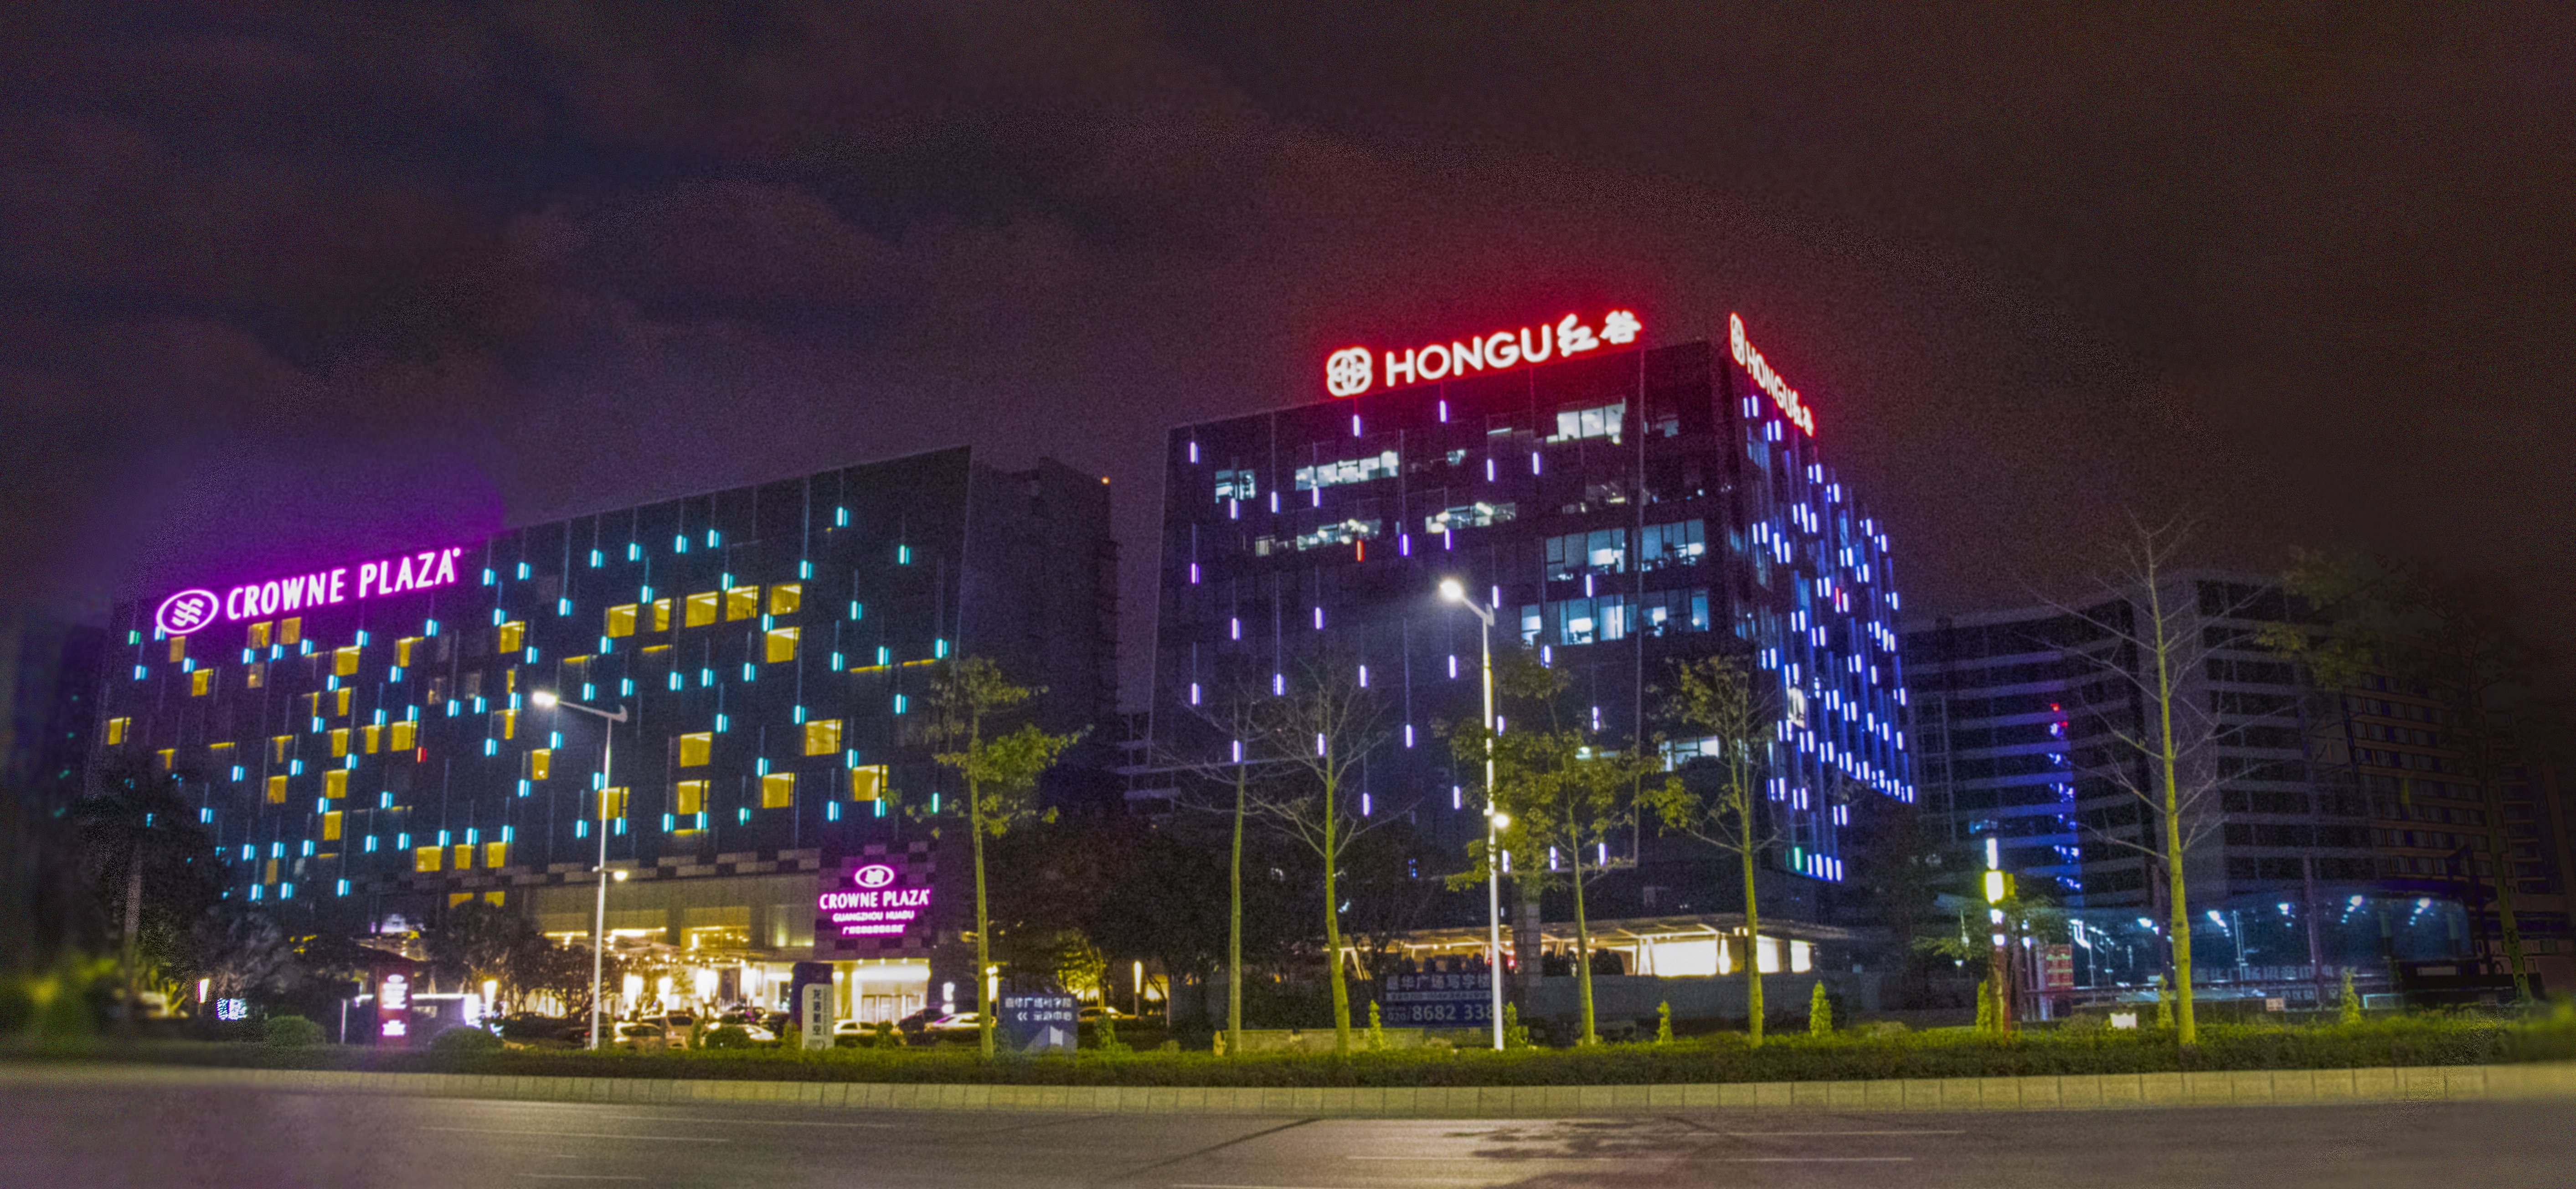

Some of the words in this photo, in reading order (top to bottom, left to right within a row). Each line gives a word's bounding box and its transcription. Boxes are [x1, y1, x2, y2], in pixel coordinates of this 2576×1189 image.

[1386, 325, 1551, 387] HONGU
[1556, 310, 1641, 357] 红谷
[1745, 341, 1793, 418] HONGU
[227, 569, 345, 620] CROWNE
[359, 549, 455, 598] PLAZA
[819, 892, 878, 910] CROWNE
[883, 889, 928, 907] PLAZA
[1412, 1005, 1456, 1021] 8682
